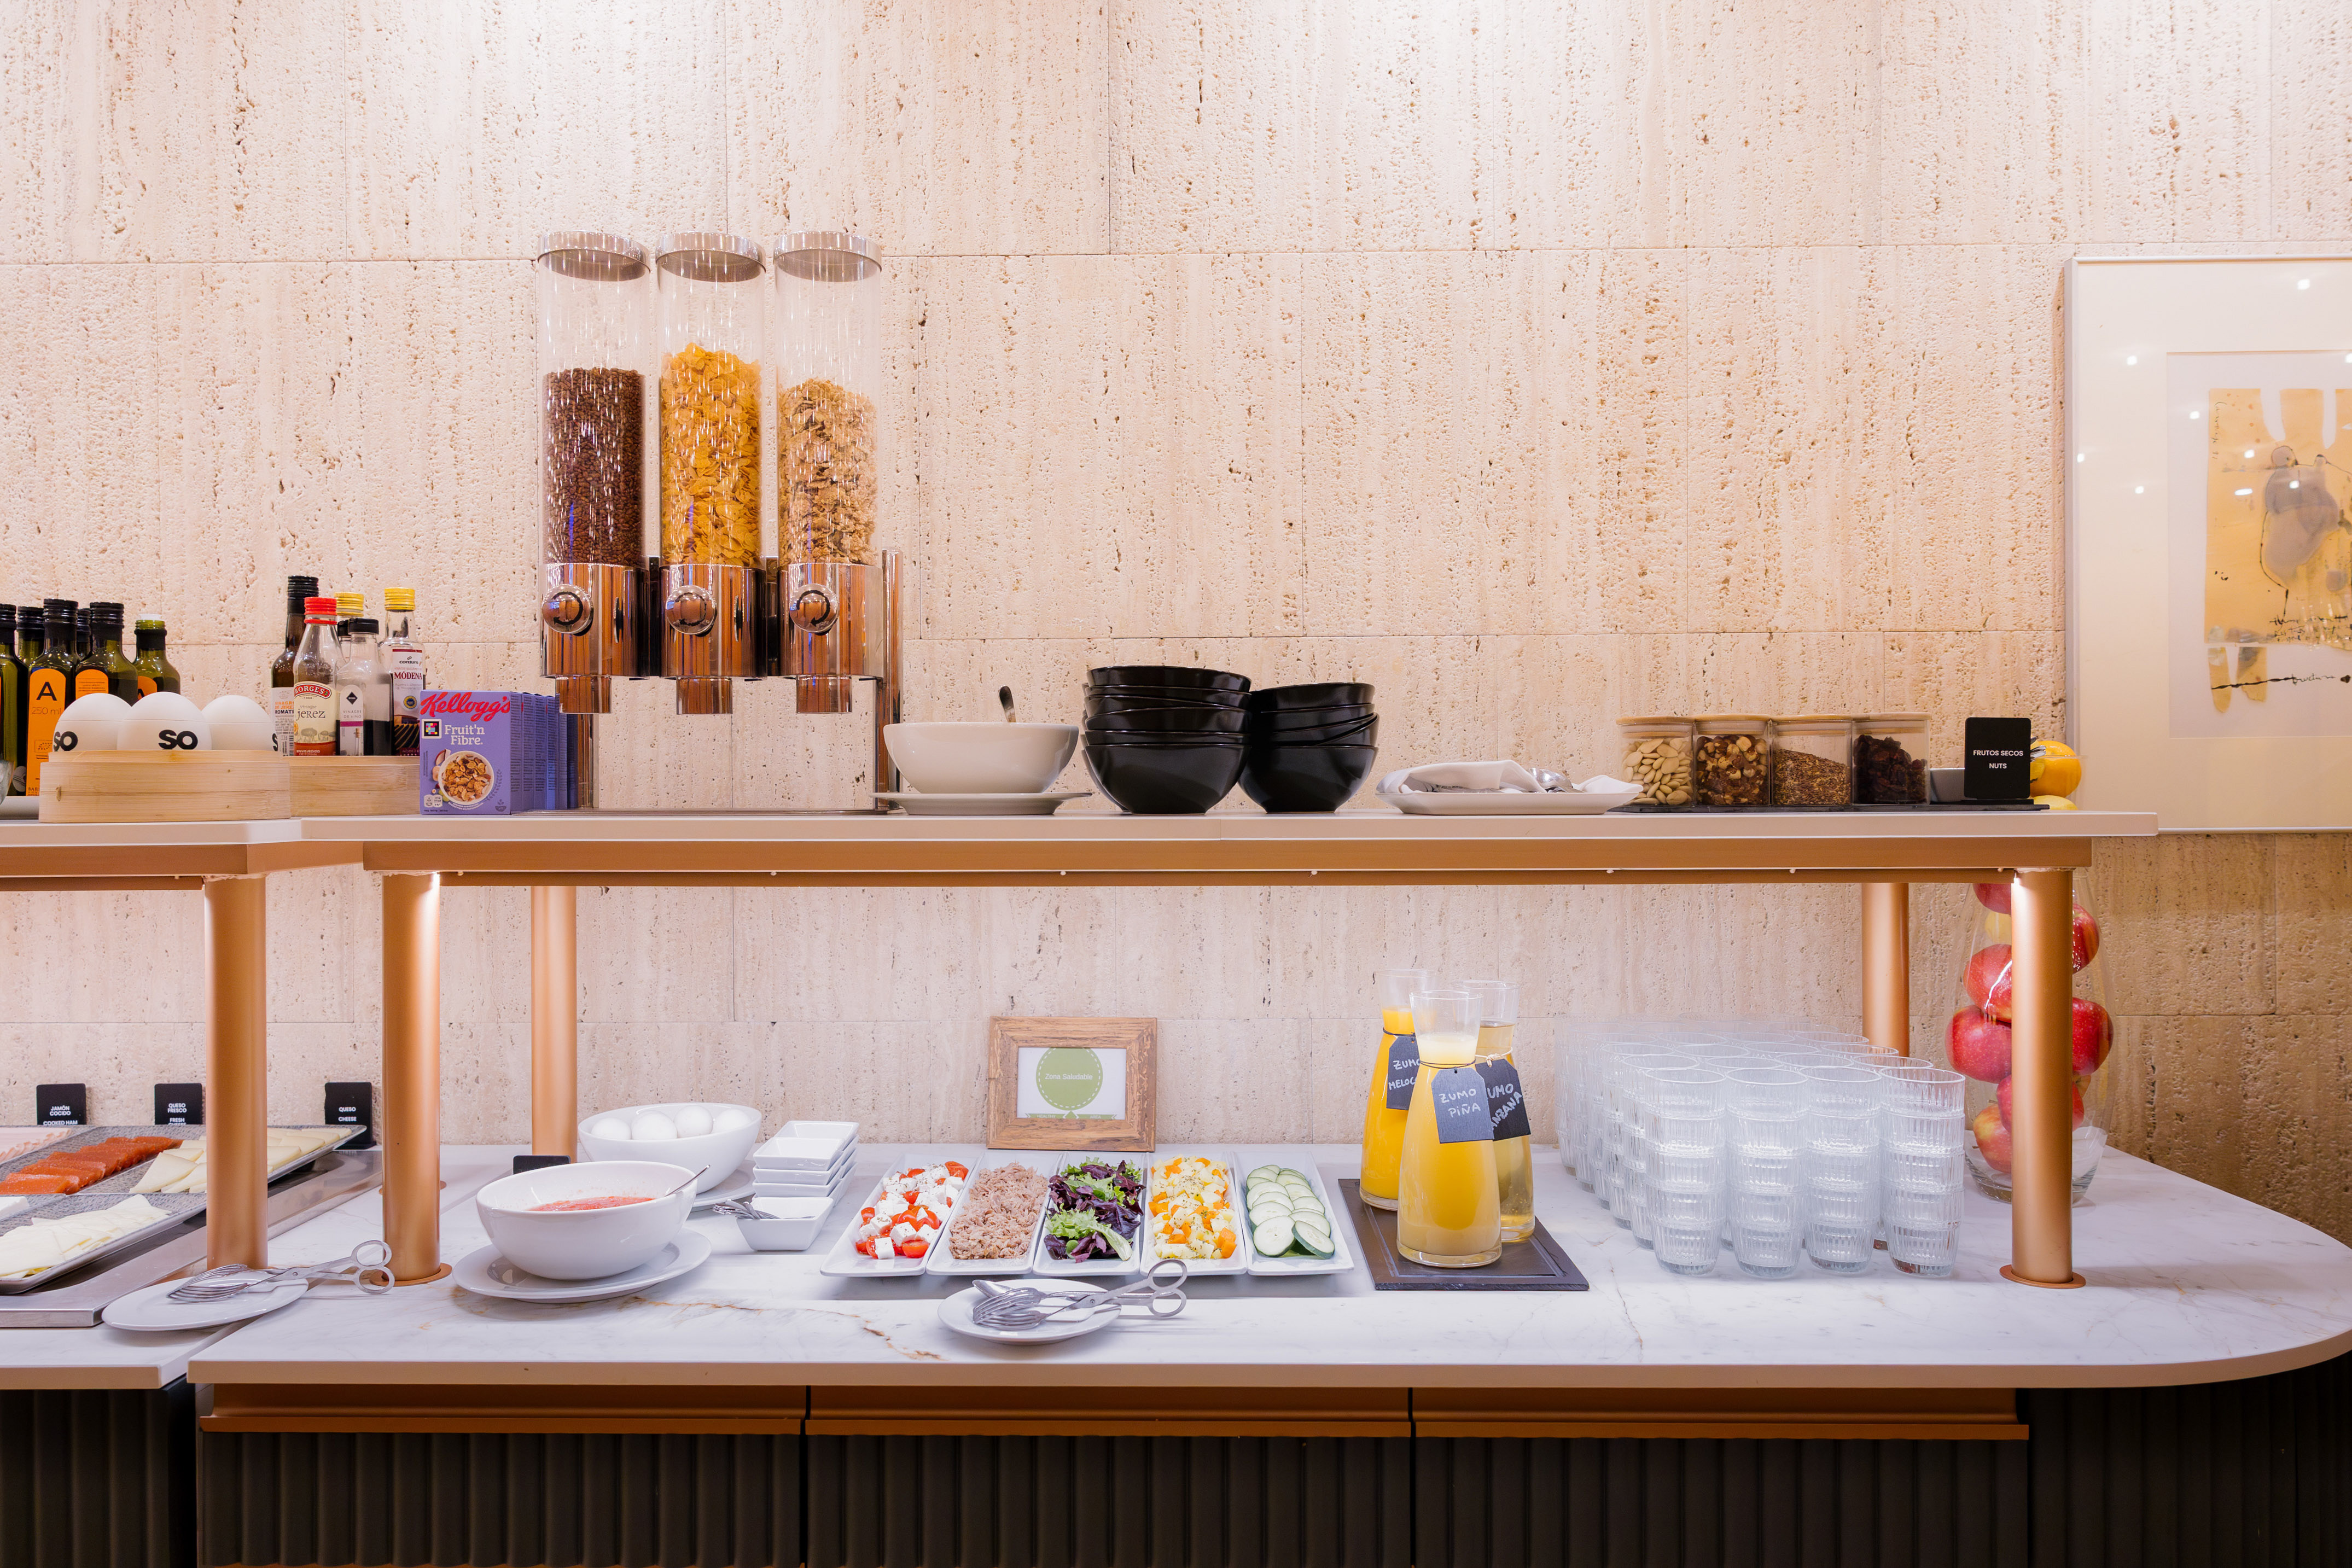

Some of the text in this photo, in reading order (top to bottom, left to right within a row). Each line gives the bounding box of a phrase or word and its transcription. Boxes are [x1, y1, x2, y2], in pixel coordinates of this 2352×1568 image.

[394, 671, 422, 680] MÓDENA
[36, 681, 57, 701] A
[420, 692, 510, 722] Kellogg's
[444, 724, 485, 735] Fruit'n
[53, 731, 78, 751] SO
[158, 729, 199, 750] SO
[1388, 1076, 1417, 1091] MELOC
[1487, 1083, 1514, 1099] UMO
[1438, 1088, 1476, 1104] ZUMO
